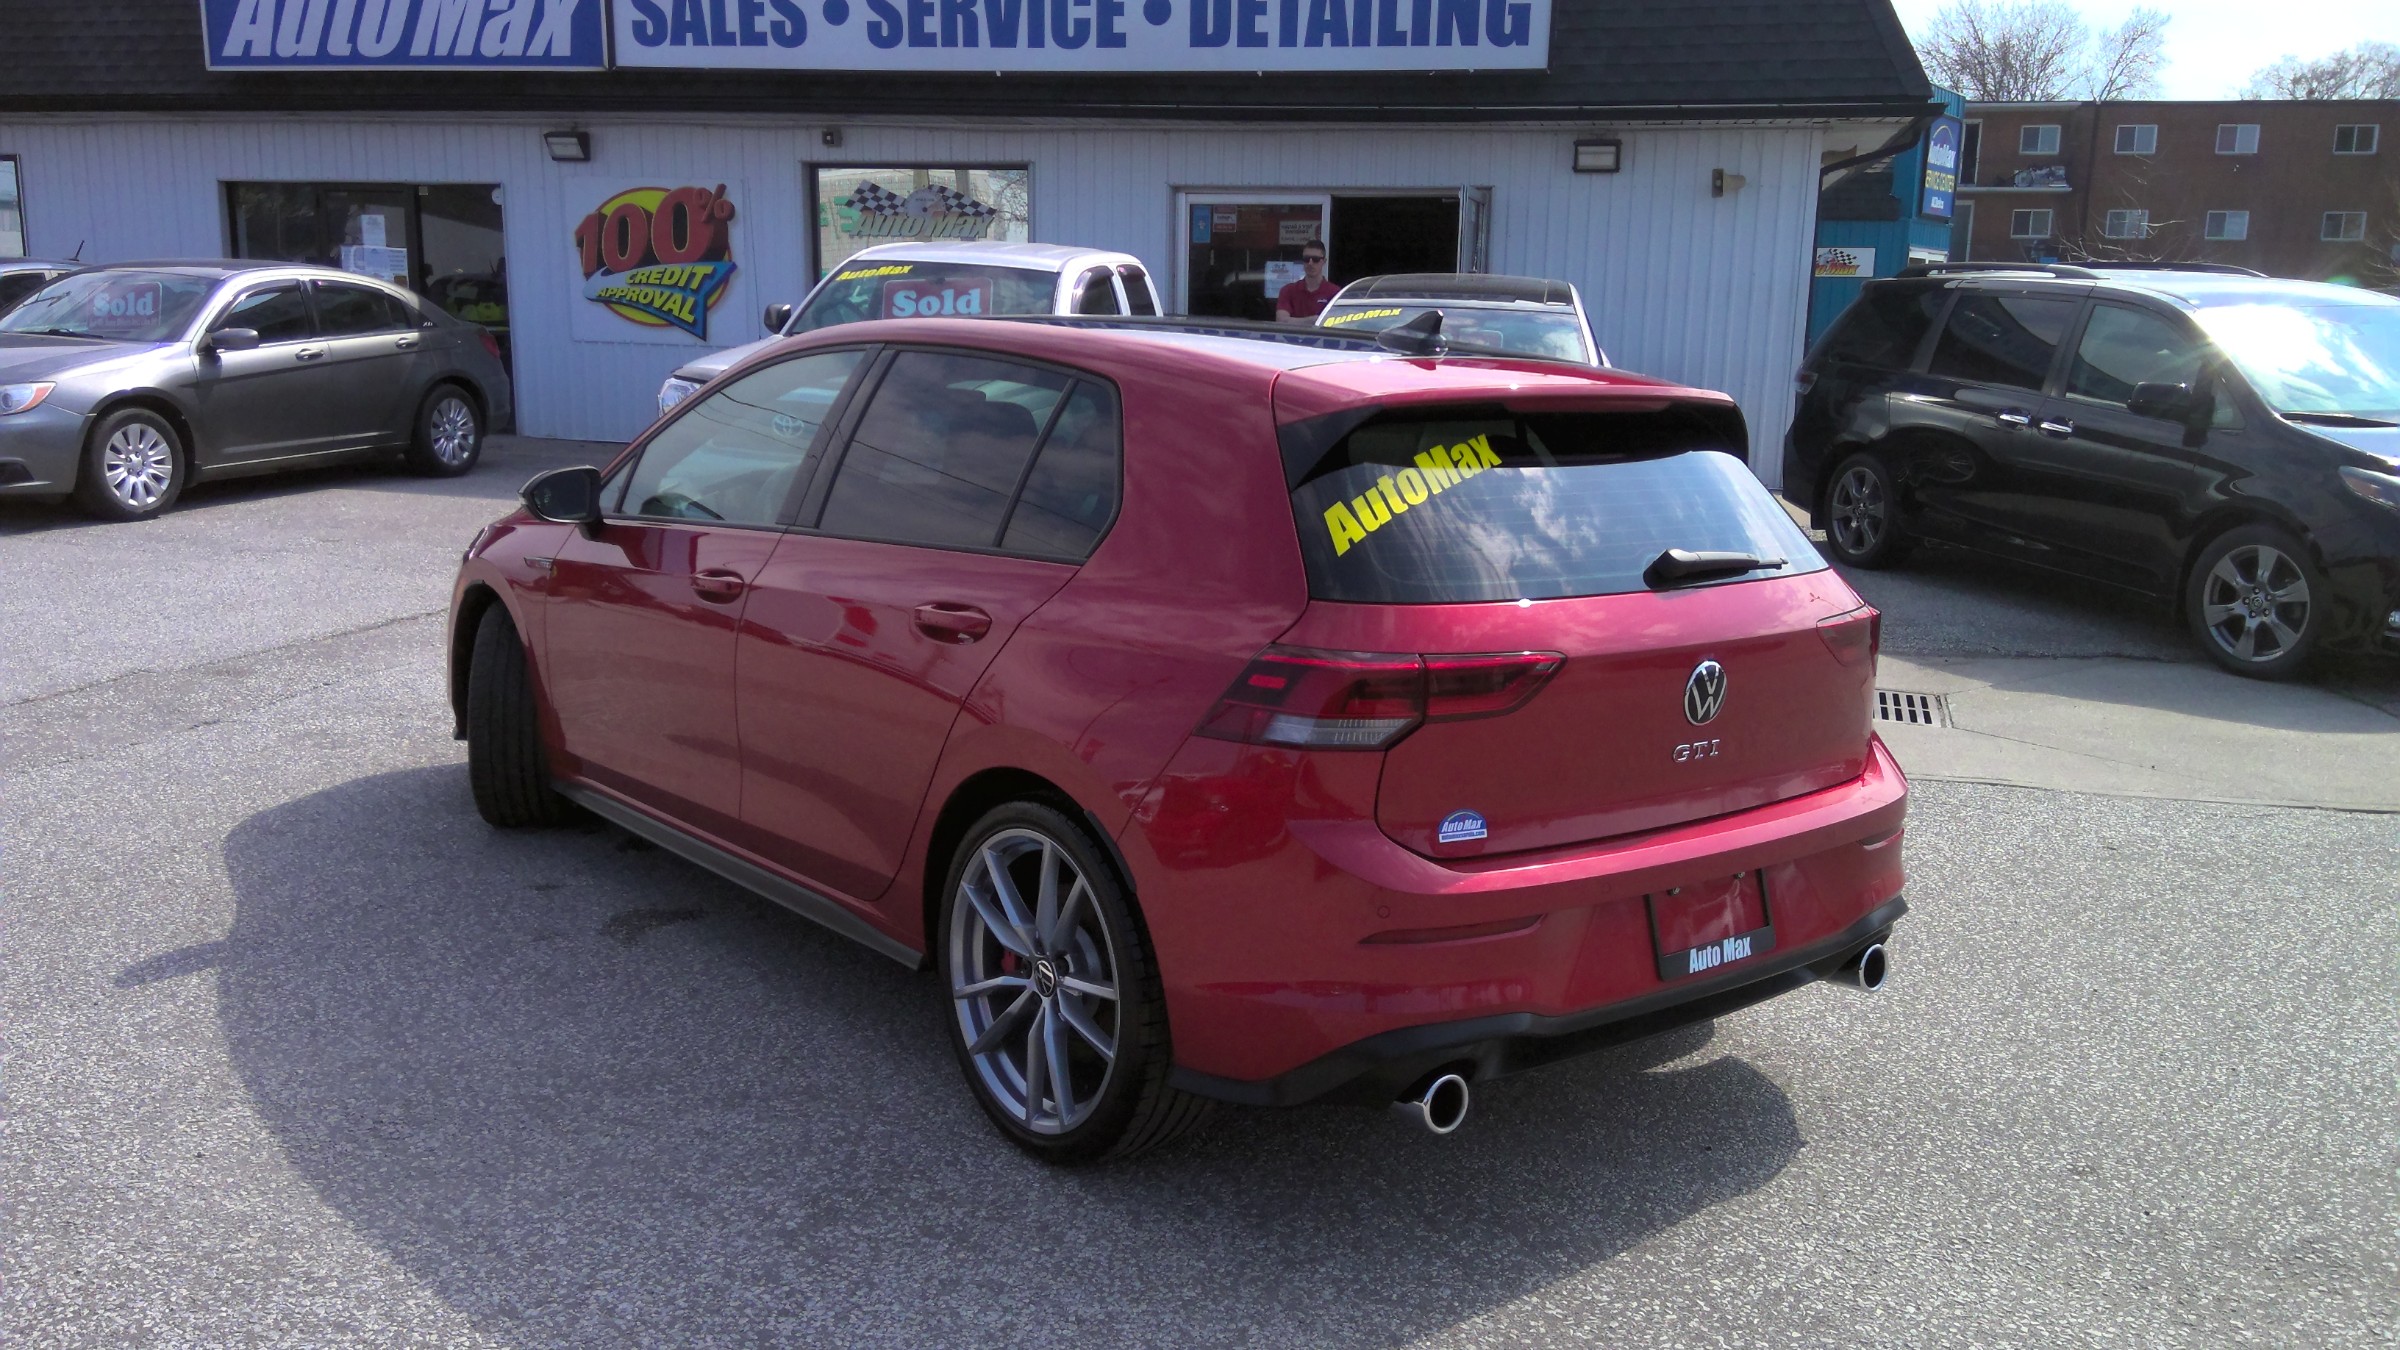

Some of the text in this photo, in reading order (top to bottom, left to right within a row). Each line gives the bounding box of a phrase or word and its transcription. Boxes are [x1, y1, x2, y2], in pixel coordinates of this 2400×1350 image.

[221, 0, 580, 58] Auto Max
[631, 0, 1531, 49] SALES SERVICE DETAILING
[575, 183, 736, 281] 100%
[625, 265, 714, 290] CREDIT
[93, 291, 155, 317] Sold
[596, 287, 696, 323] APPROVAL
[892, 287, 982, 317] Sold
[1323, 433, 1502, 558] AutoMax
[1673, 739, 1721, 763] GTI
[1689, 936, 1752, 974] Auto Max
